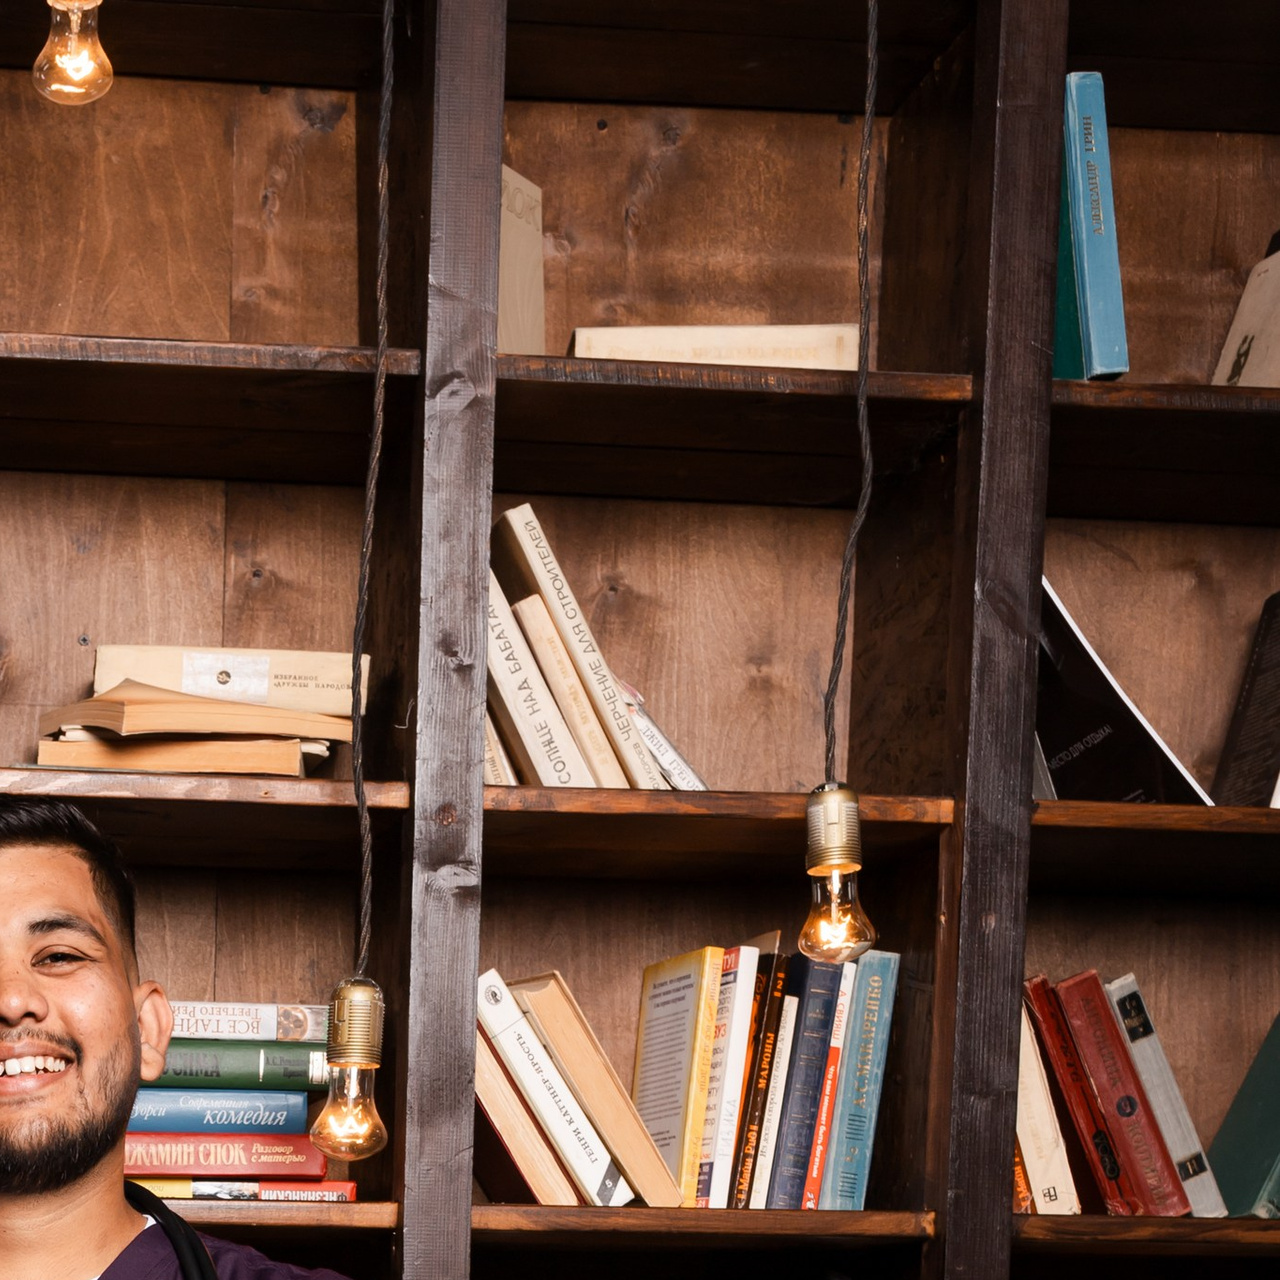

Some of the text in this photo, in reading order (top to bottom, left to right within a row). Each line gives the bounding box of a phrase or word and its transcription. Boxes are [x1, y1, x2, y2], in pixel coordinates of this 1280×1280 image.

[1080, 115, 1104, 236] АЛЕКСАНДР ГРИН
[521, 517, 636, 742] ЧЕРЧЕНИЕ ДЛЯ СТРОИТЕЛЕЙ
[273, 673, 318, 681] ИЗБРАННОЕ
[514, 676, 574, 786] СОЛНЦЕ НАД
[1045, 748, 1073, 772] МЕСТО
[173, 1015, 261, 1036] ВСЕ ТАЙН
[831, 1001, 845, 1041] СВИЯШ
[851, 973, 884, 1108] А.С.МАКАРЕНКО
[756, 1031, 775, 1090] МАРОНЫ
[179, 1095, 249, 1109] Современная
[202, 1101, 287, 1125] комедия
[511, 1032, 599, 1165] ГЕНРИ КАТТНЕР ЯРОСТЬ
[819, 1096, 830, 1126] мешает
[197, 1141, 248, 1168] СПОК
[251, 1142, 294, 1155] Разговор
[743, 1129, 759, 1155] Рид
[257, 1152, 306, 1165] матерью
[736, 1156, 755, 1191] Майн
[810, 1144, 824, 1178] богатым
